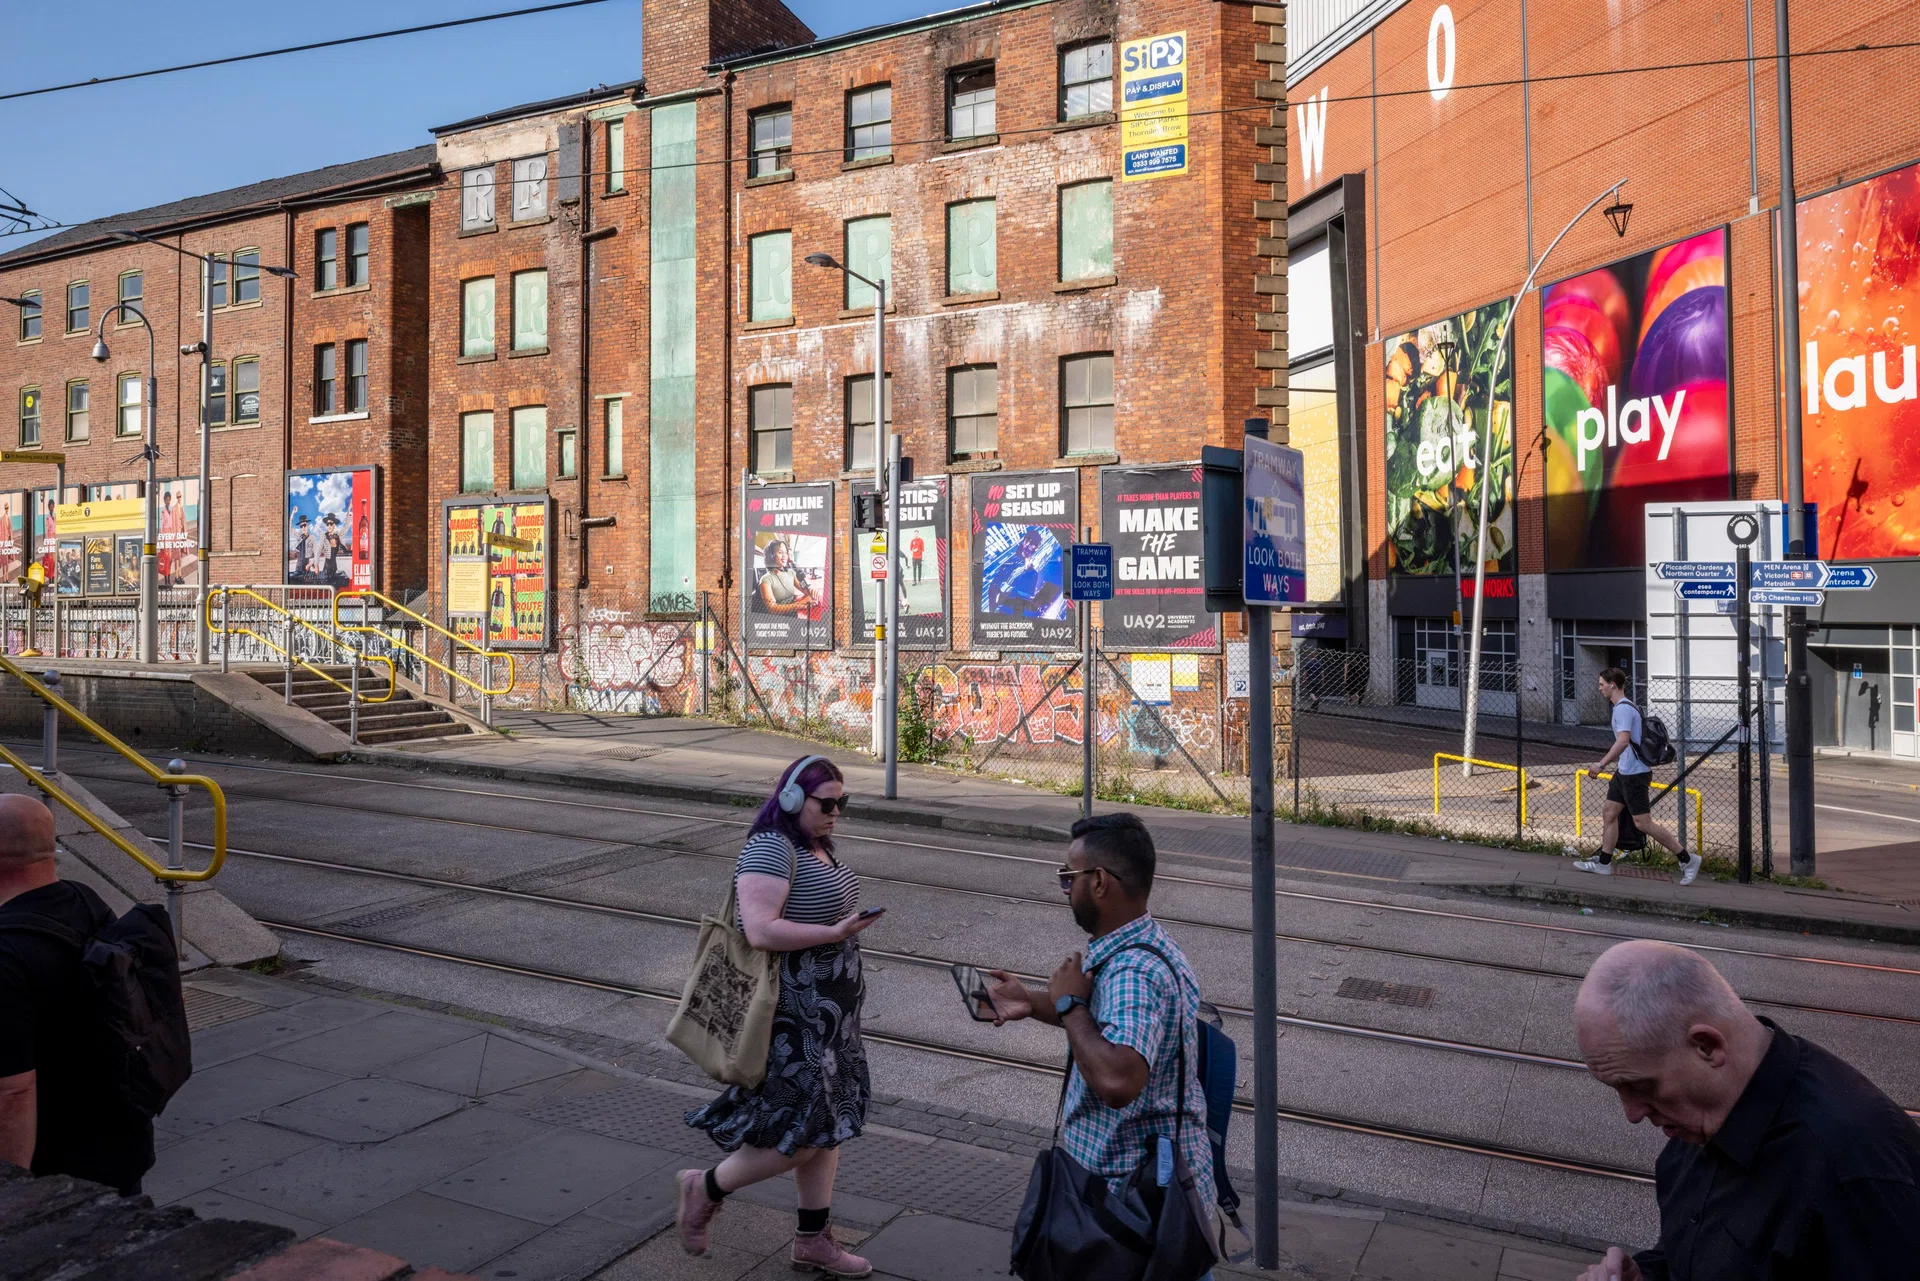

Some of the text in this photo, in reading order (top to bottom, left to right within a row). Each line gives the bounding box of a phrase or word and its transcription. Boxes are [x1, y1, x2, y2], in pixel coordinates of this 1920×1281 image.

[1126, 79, 1181, 95] PAY & DISPLAY
[1297, 4, 1456, 181] W O
[1133, 109, 1167, 119] Welcome
[1143, 119, 1156, 127] Car
[1162, 124, 1182, 132] Brow
[1131, 148, 1178, 160] LAND WANTED
[466, 170, 493, 222] R
[1806, 341, 1918, 415] lau
[1576, 385, 1687, 471] play
[1416, 423, 1477, 476] eat
[1252, 449, 1297, 477] TRAMWAY
[1005, 484, 1034, 499] SET
[1038, 482, 1060, 498] UP
[1123, 494, 1138, 502] TAKES
[1140, 493, 1154, 501] MORE
[1155, 492, 1169, 501] THAN
[1170, 491, 1192, 500] PLAYERS
[1193, 491, 1200, 499] TO
[763, 496, 823, 511] HEADLINE
[1001, 500, 1065, 517] SEASON
[60, 508, 82, 518] Shudehill
[775, 513, 809, 526] HYPE
[1119, 507, 1199, 533] MAKE
[176, 532, 188, 540] DAY
[455, 531, 474, 543] BOSS?
[520, 528, 540, 540] BOSS?
[173, 541, 195, 549] ICONIC
[1140, 532, 1178, 556] THE
[1077, 548, 1107, 556] TRAMWAY
[1248, 545, 1302, 570] LOOK BOTH
[1118, 555, 1200, 581] GAME
[1665, 564, 1696, 572] Piccadilly
[1831, 569, 1855, 577] Arena
[1074, 581, 1110, 589] LOOK BOTH
[1262, 572, 1290, 593] WAYS
[1083, 589, 1101, 597] WAYS
[1186, 587, 1204, 595] SUCCESS
[1768, 594, 1801, 602] Cheetham
[516, 601, 542, 611] ROUTE
[980, 622, 999, 630] WITHOUT
[1000, 622, 1008, 630] THE
[1123, 614, 1165, 630] UA92
[801, 627, 827, 638] UA92
[986, 630, 1003, 638] THERE'S
[1004, 630, 1010, 638] NO
[1041, 627, 1072, 639] UA92
